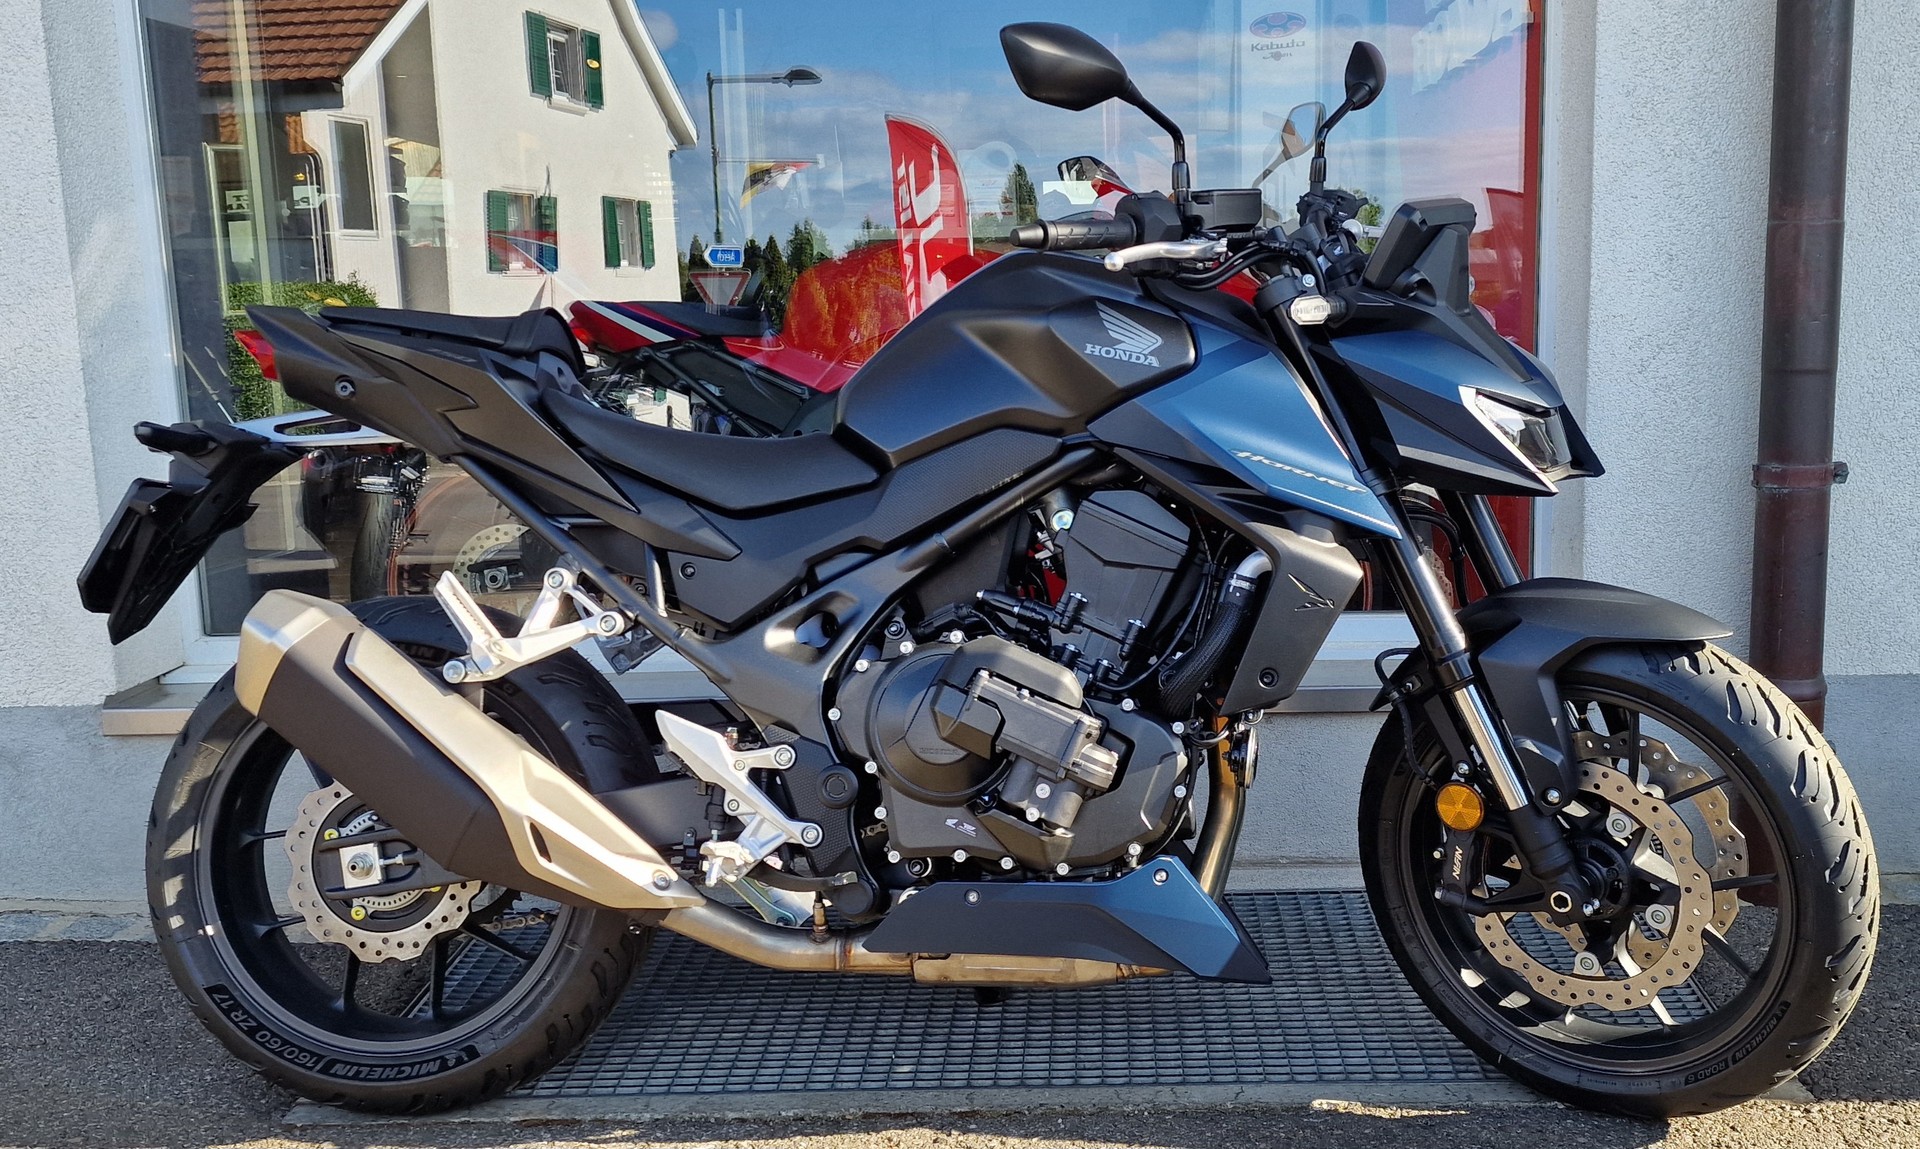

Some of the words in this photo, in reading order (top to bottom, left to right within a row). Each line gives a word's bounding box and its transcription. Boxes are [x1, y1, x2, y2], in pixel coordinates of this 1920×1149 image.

[1249, 38, 1306, 53] Kabuto
[1083, 342, 1161, 368] HONDA
[211, 993, 235, 1009] 17
[230, 1009, 258, 1031] ZR
[1735, 1015, 1779, 1059] MICHELIN
[255, 1030, 319, 1067] 160/60
[329, 1058, 441, 1080] MICHELIN
[1697, 1060, 1727, 1079] ROAD
